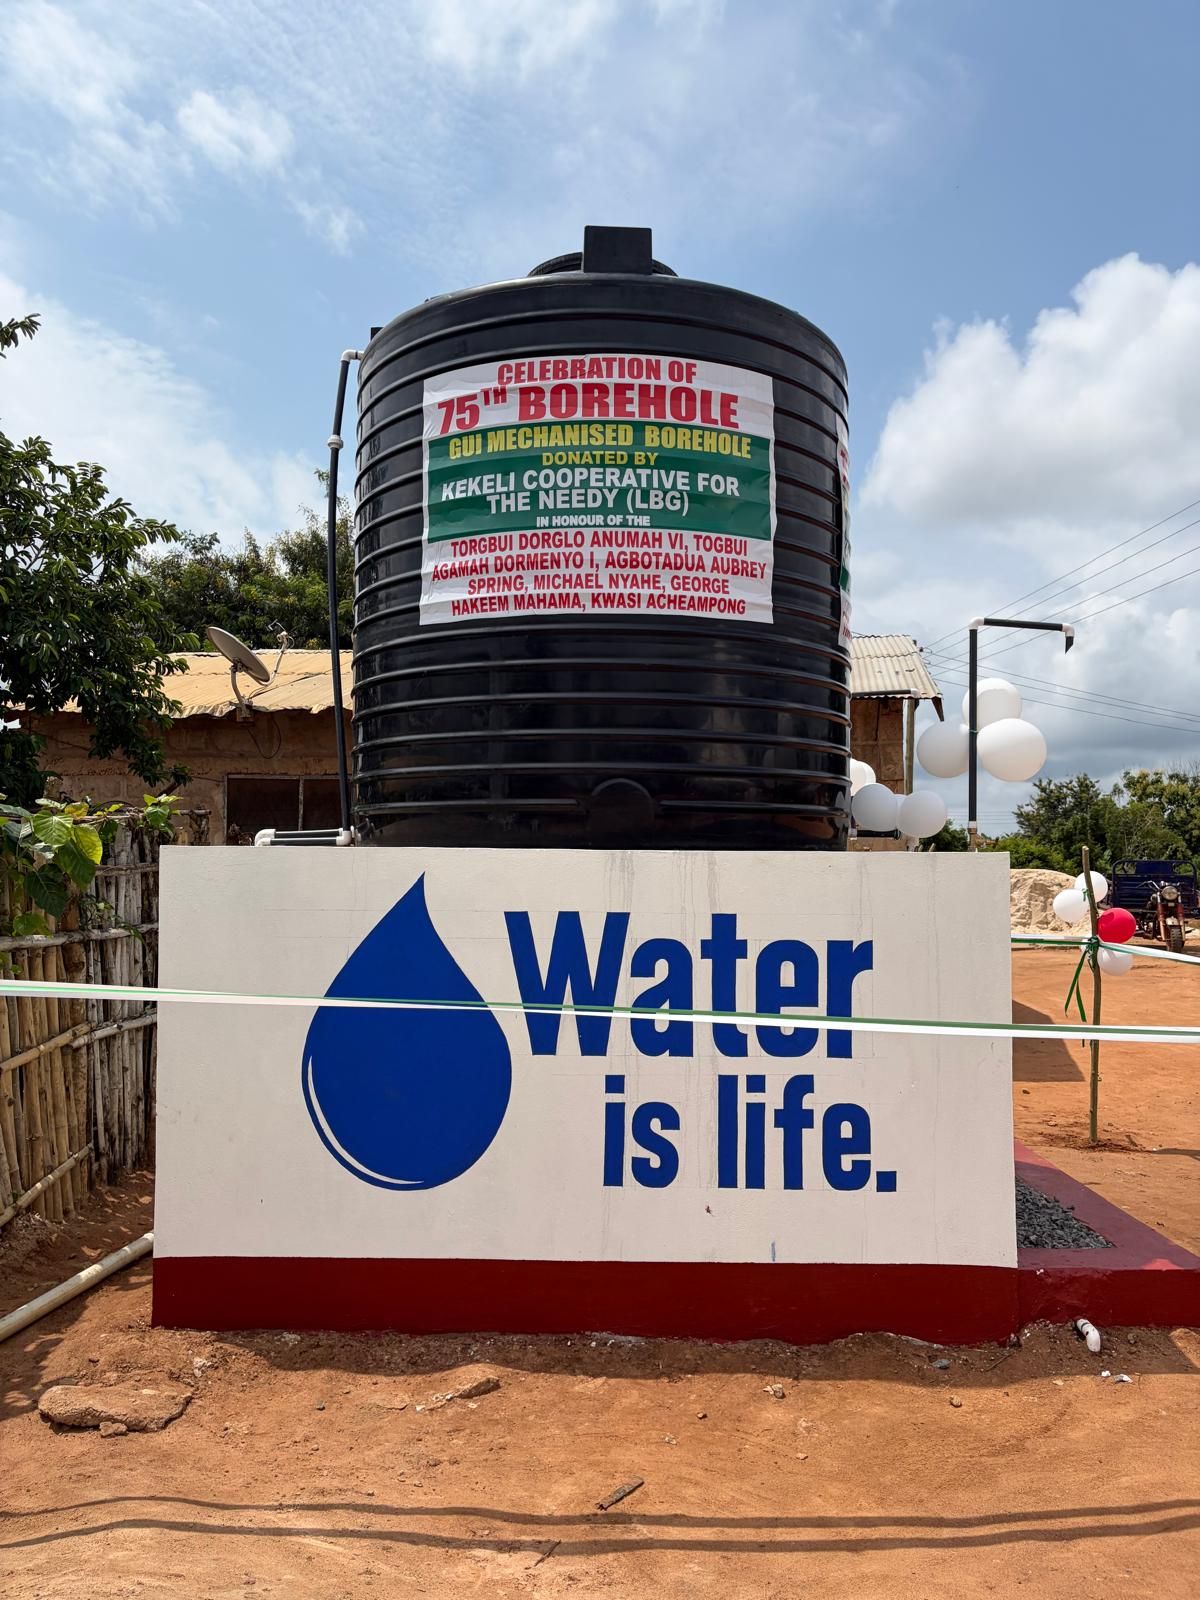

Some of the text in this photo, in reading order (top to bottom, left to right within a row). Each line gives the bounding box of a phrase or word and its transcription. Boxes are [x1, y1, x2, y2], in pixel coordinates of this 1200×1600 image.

[498, 357, 696, 385] CELEBRATION OF
[518, 383, 739, 429] BOREHOLE
[449, 424, 751, 459] GUI MECHANISED BOREHOLE
[542, 451, 659, 466] DONATED BY
[441, 467, 740, 501] KEKELI COOPERATIVE FOR
[486, 488, 689, 516] THE NEEDY (LBG)
[536, 514, 650, 527] IN HONOUR OF THE
[451, 530, 747, 558] TORGBUI DORGLO ANUMAH VI, TOGBUI
[432, 551, 767, 581] AGAMAH DORMENYO I, AGBOTADUA AUBREY
[467, 573, 730, 595] SPRING, MICHAEL NYAHE, GEORGE
[451, 592, 746, 616] HAKEEM MAHAMA, KWASI ACHEAMPONG
[503, 911, 873, 1059] Water
[603, 1074, 897, 1193] is life.
